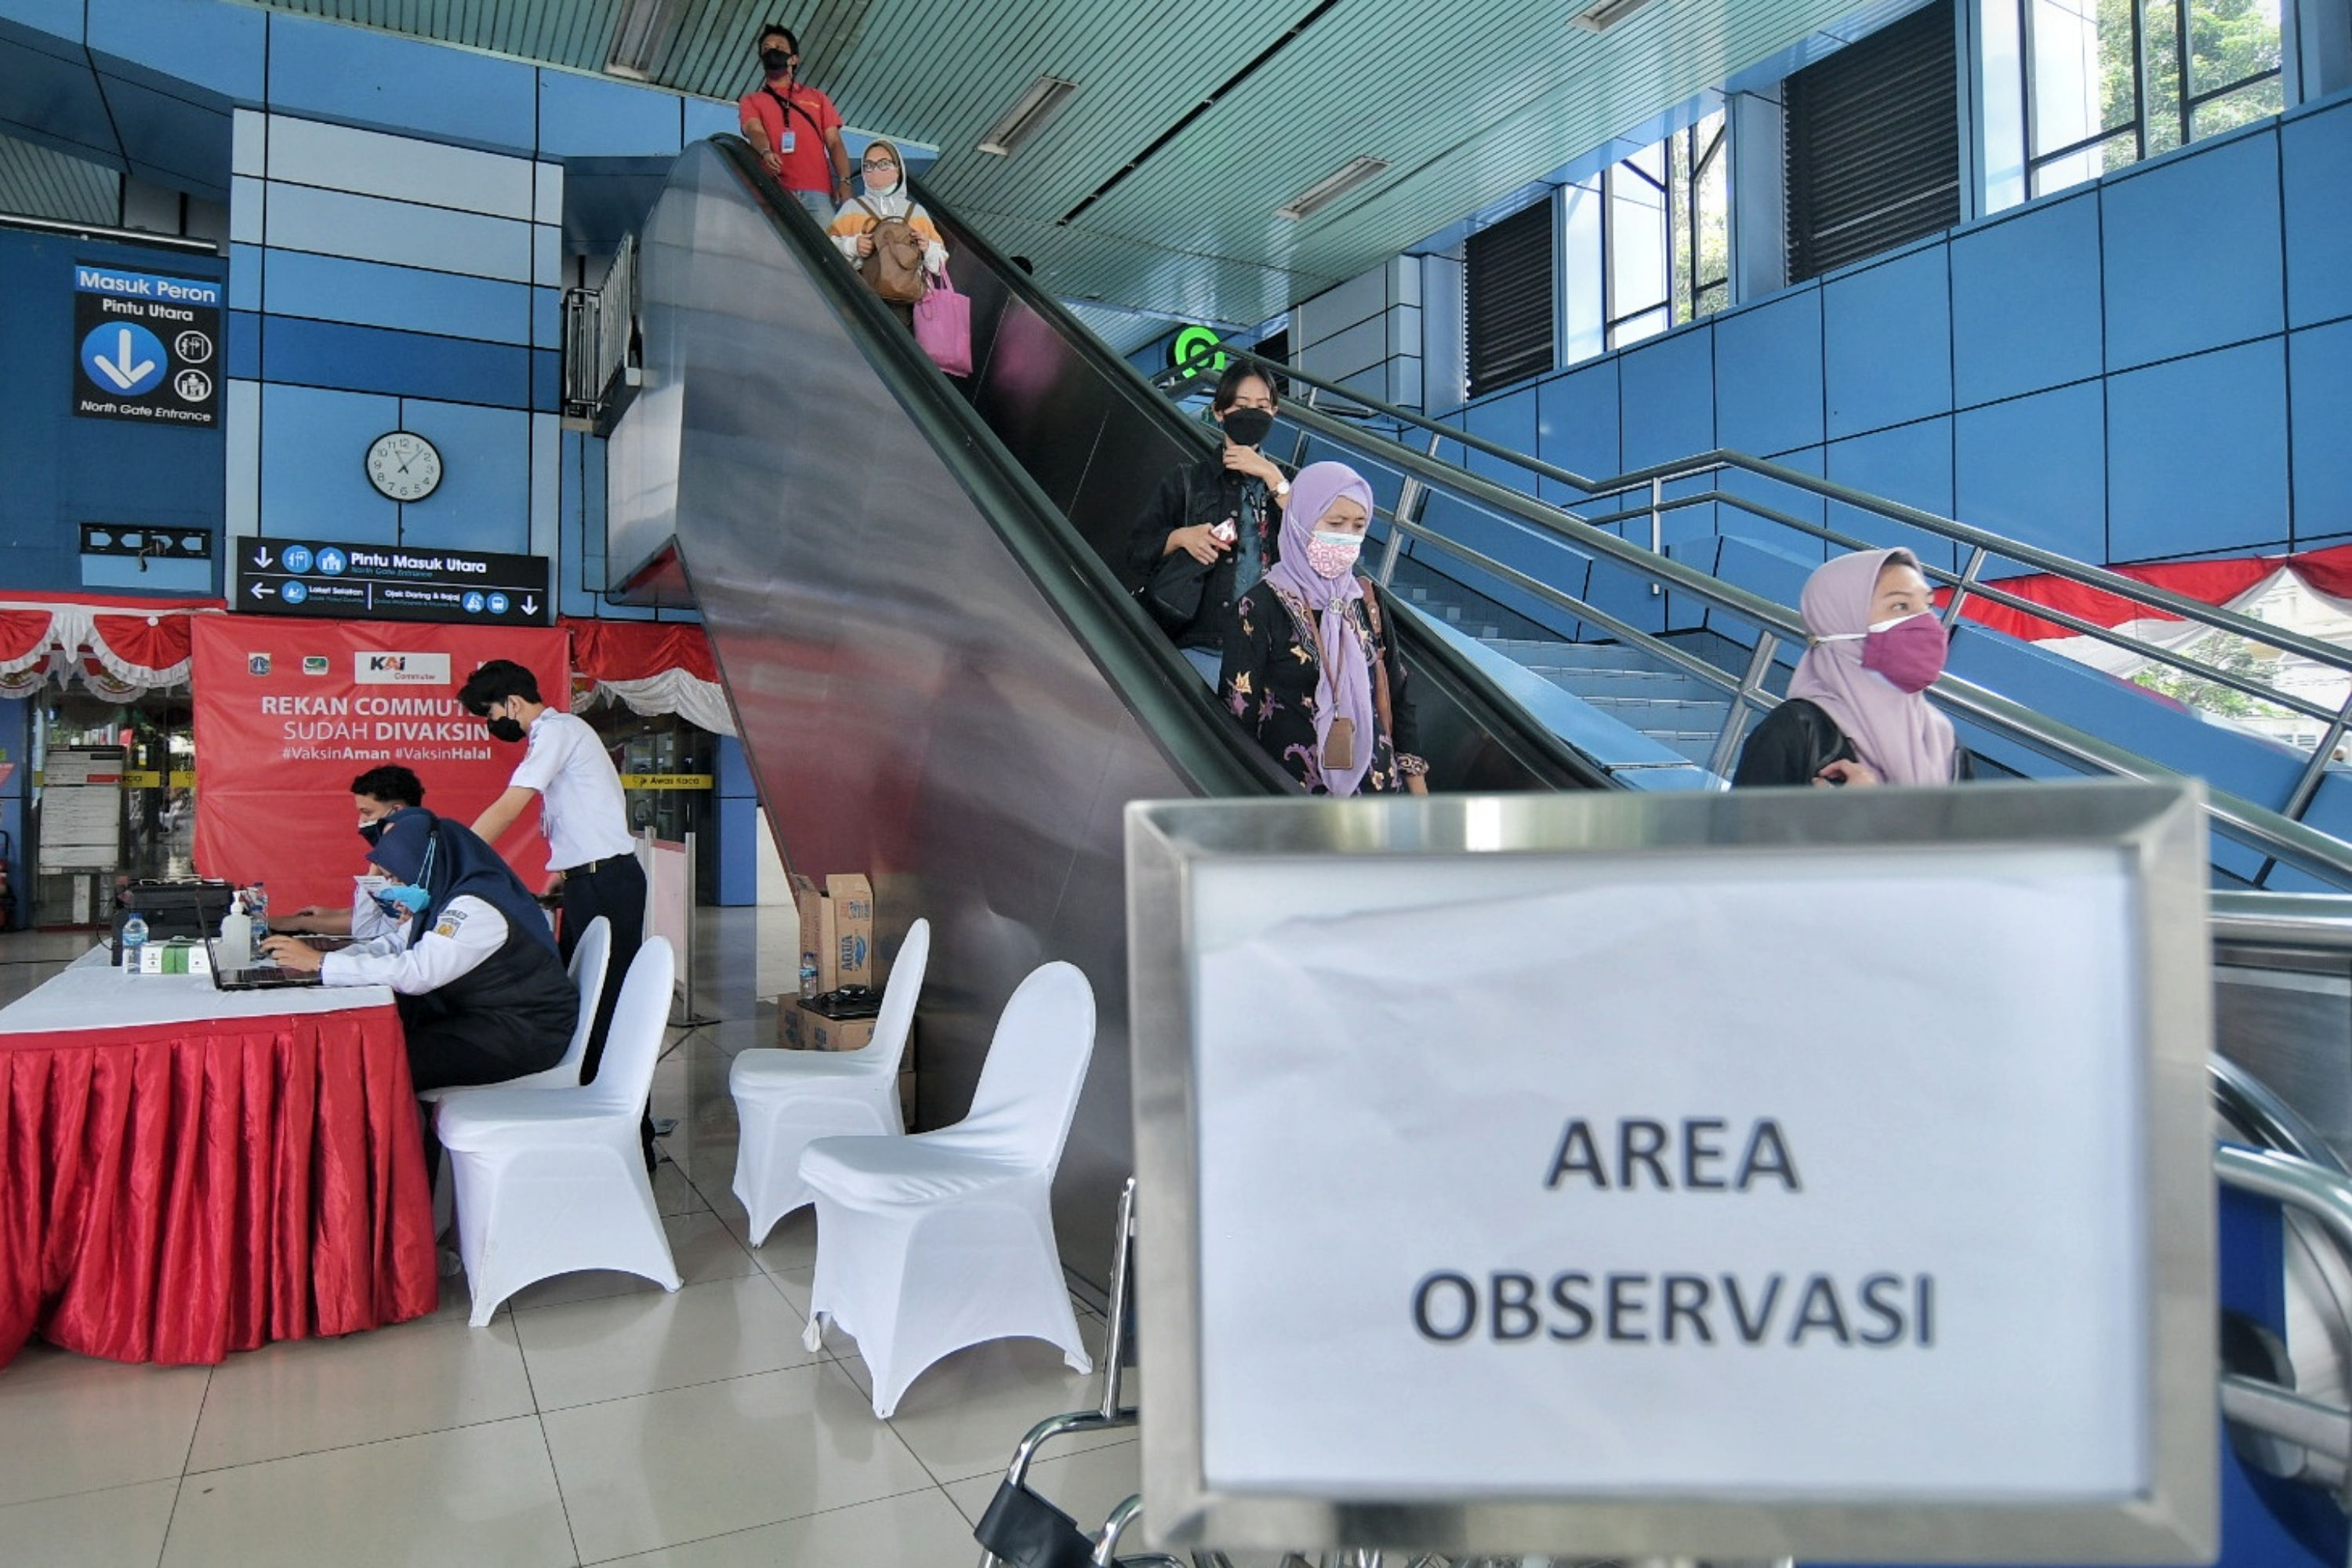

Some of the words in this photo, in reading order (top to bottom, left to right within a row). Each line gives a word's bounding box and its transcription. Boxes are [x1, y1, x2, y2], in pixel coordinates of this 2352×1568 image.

[80, 270, 151, 295] Masuk
[158, 281, 216, 303] Peron
[103, 298, 143, 315] Pintu
[149, 304, 194, 321] Utara
[81, 401, 117, 413] North
[120, 404, 152, 416] Gate
[154, 408, 212, 422] Entrance
[351, 552, 389, 567] Pintu
[393, 554, 443, 570] Masuk
[446, 557, 487, 573] Utara
[262, 696, 348, 716] REKAN
[354, 697, 480, 717] COMMUT
[284, 721, 368, 740] SUDAH
[376, 721, 490, 741] DIVAKSIN
[283, 746, 390, 760] #VaksinAman
[395, 746, 492, 760] #VaksinHalal
[841, 935, 853, 971] AQUA
[1546, 1116, 1801, 1191] AREA
[1414, 1270, 1934, 1346] OBSERVASI
